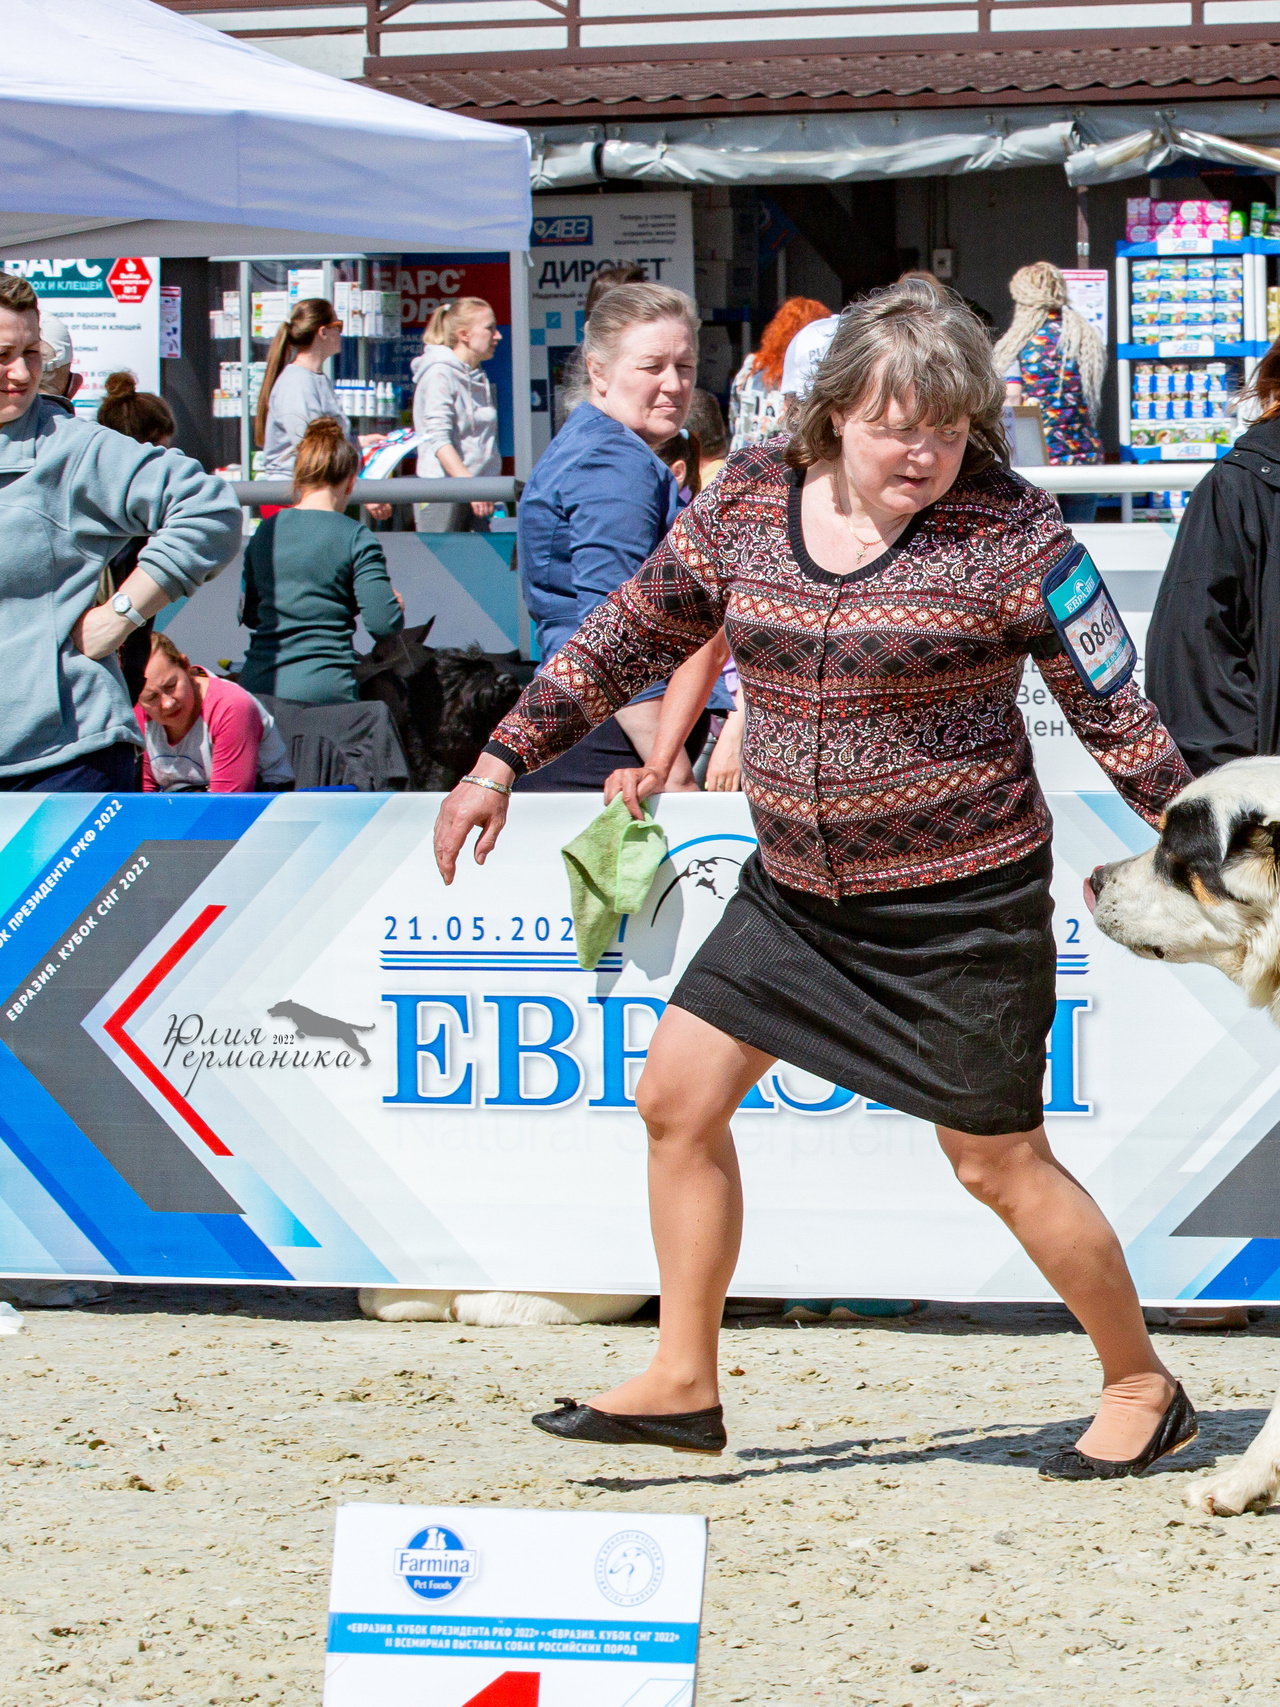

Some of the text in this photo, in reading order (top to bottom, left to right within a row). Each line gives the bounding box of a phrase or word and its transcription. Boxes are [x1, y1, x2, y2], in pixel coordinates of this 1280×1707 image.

[538, 257, 666, 289] ДИРЕТ
[57, 279, 104, 292] КЛЕЩЕЙ
[8, 799, 123, 933] ПРЕЗИДЕНТА РКФ 2022
[5, 855, 151, 1022] ЕВРАЗИЯ. КУБОК СНГ 2022
[383, 915, 574, 941] 21.05.202
[399, 1552, 470, 1573] Farmina
[413, 1579, 453, 1591] Pet Foods
[396, 1624, 428, 1636] КУБОК
[429, 1624, 490, 1638] ПРЕЗИДЕНТА
[492, 1626, 513, 1638] РКФ
[598, 1630, 632, 1642] КУБОК
[633, 1631, 653, 1642] СНГ
[394, 1638, 451, 1650] ВСЕМИРНАЯ
[452, 1639, 502, 1651] ВЫСТАВКА
[504, 1640, 536, 1653] СОБАК
[537, 1640, 602, 1654] РОССИЙСКИХ
[603, 1643, 638, 1657] ПОРОД
